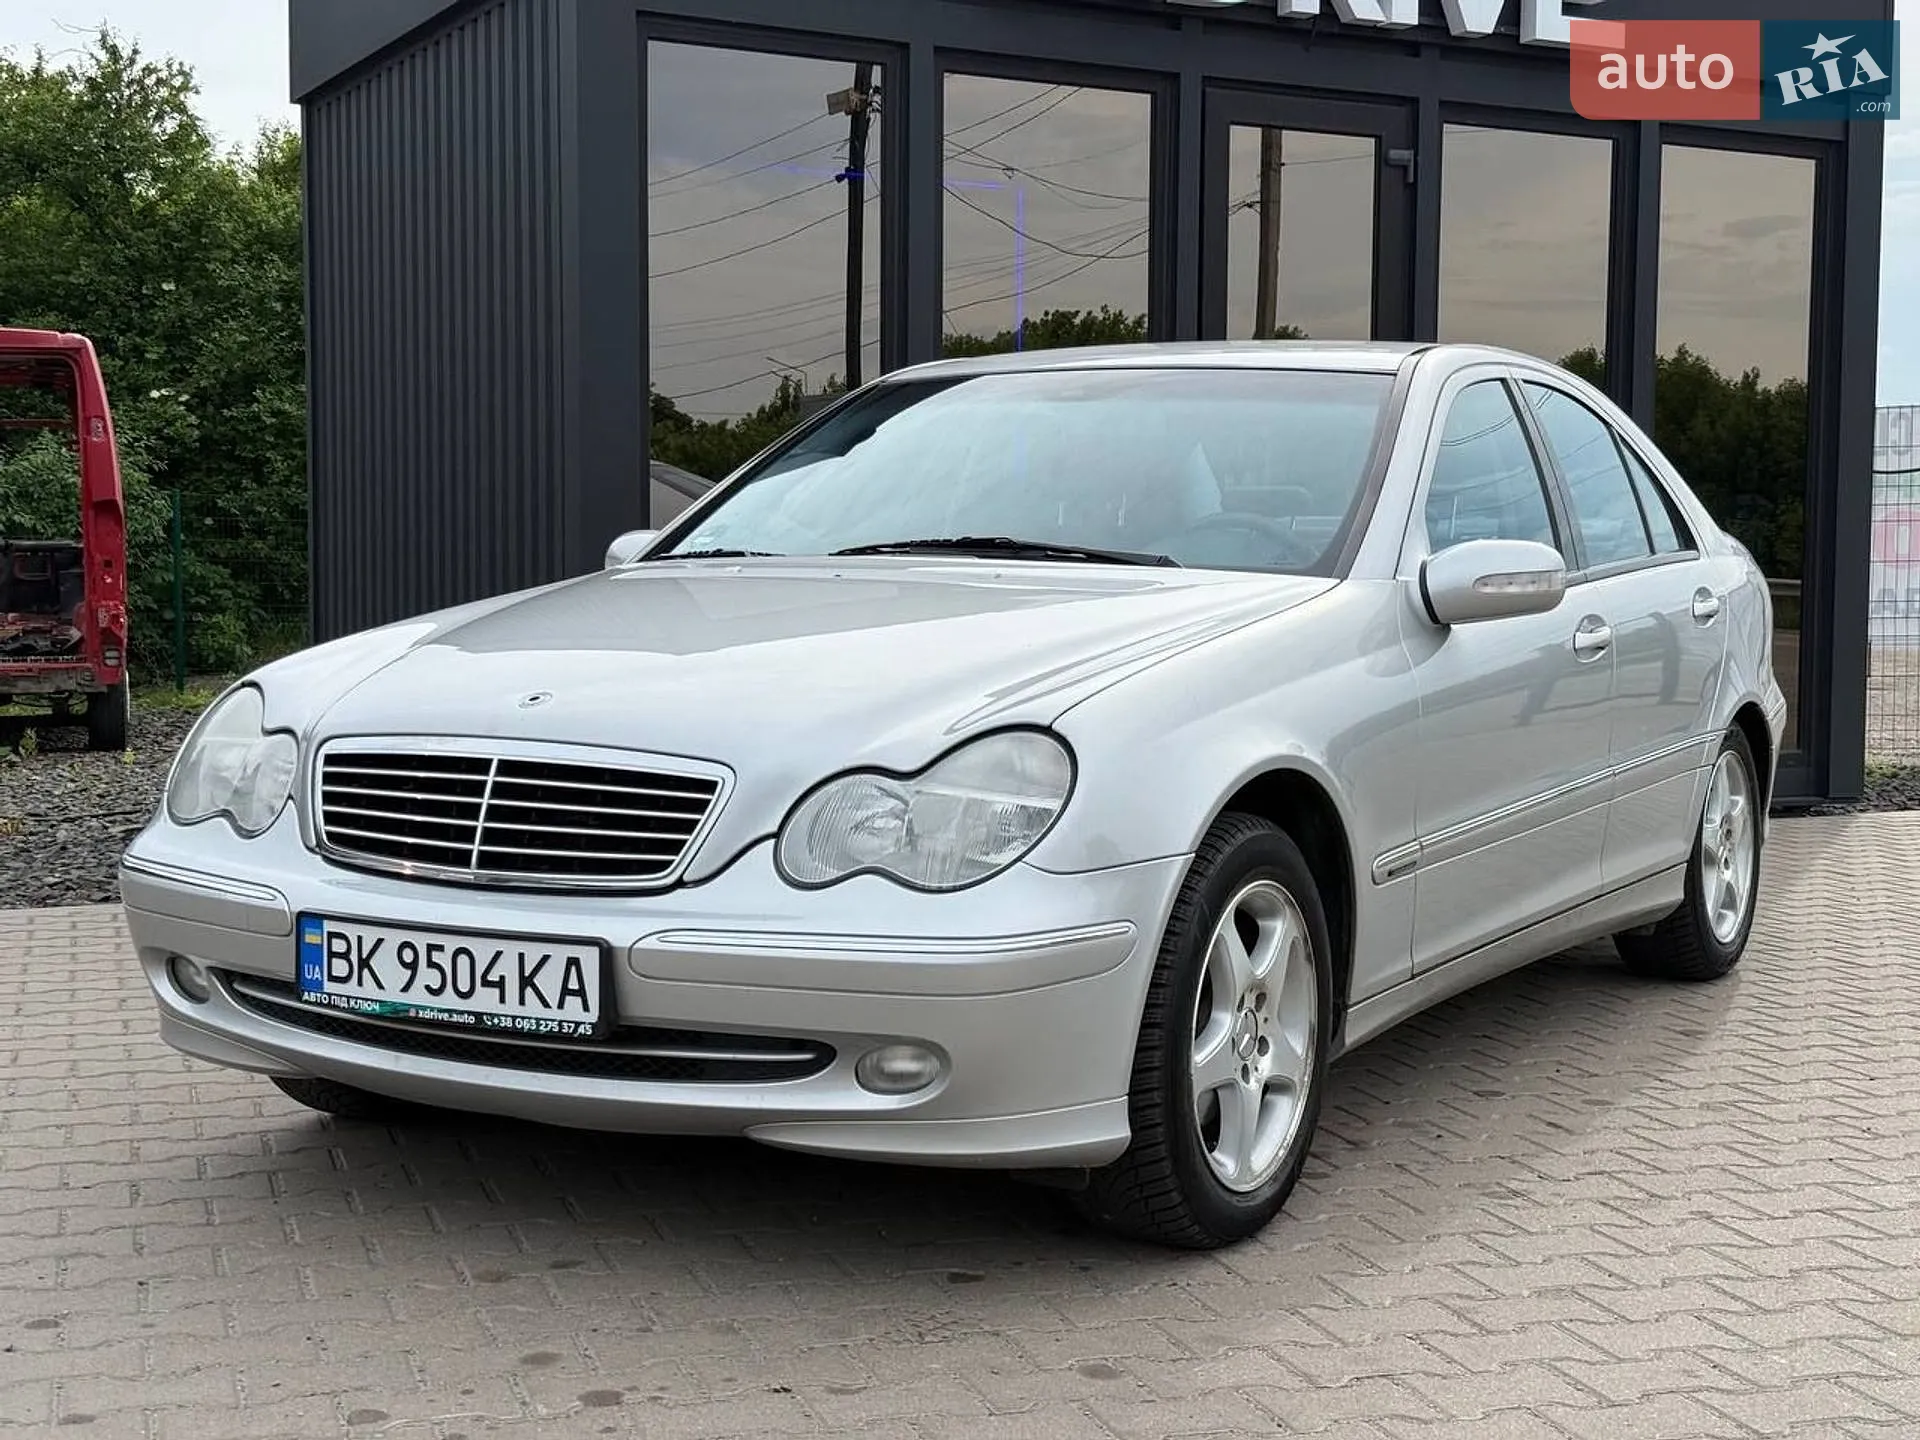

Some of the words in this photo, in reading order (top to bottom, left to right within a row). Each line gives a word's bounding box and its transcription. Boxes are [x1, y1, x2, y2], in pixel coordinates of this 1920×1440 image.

[304, 964, 322, 981] UA
[326, 930, 386, 990] BK
[396, 939, 507, 1004] 9504
[517, 951, 591, 1013] KA
[302, 991, 329, 1005] АВТО
[330, 995, 349, 1009] ПІД
[349, 999, 380, 1012] КЛЮЧ
[418, 1007, 476, 1024] xdrive.auto
[493, 1017, 513, 1028] +38
